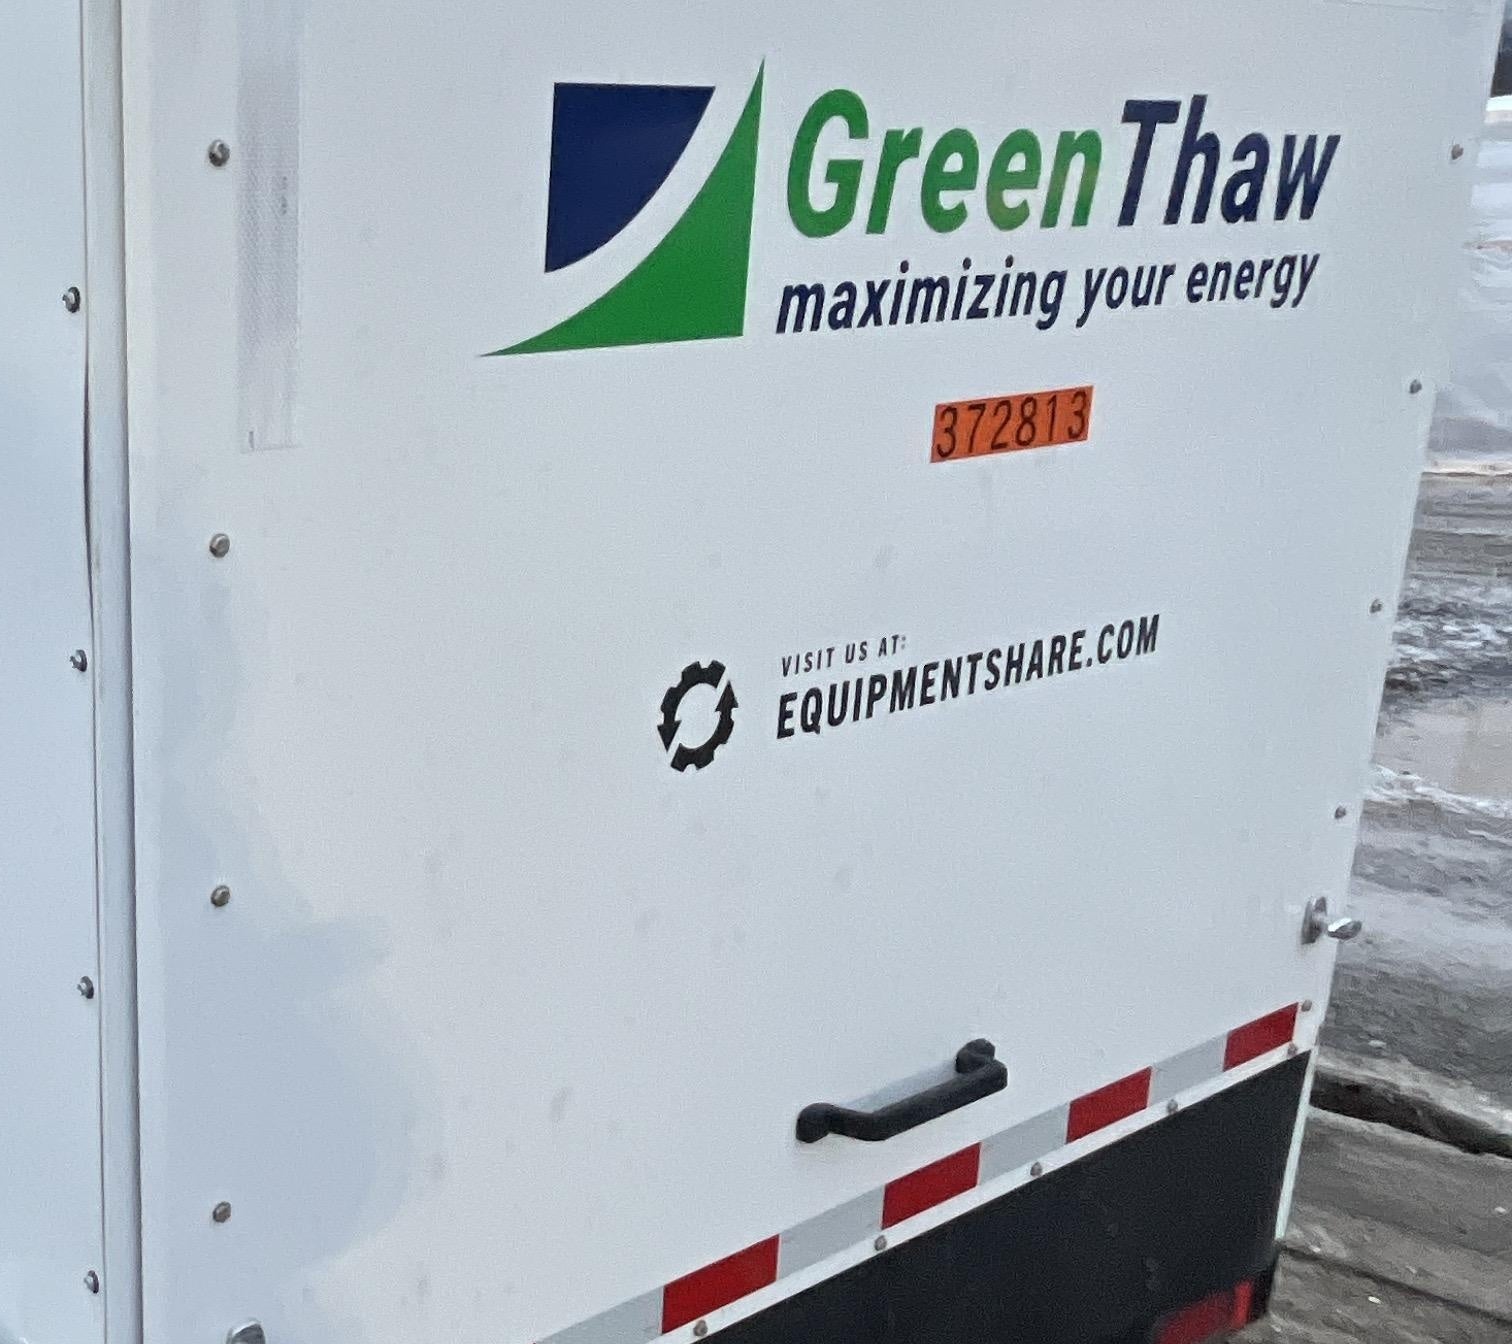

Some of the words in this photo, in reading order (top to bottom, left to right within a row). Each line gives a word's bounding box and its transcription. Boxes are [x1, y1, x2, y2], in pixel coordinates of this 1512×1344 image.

[775, 254, 1068, 335] maximizing
[1075, 263, 1176, 328] your
[1186, 253, 1321, 310] energy
[935, 388, 1089, 459] 372813
[776, 613, 1160, 740] EQUIPMENTSHARE.COM
[781, 646, 836, 678] VISIT
[845, 641, 868, 664] US
[878, 634, 907, 658] AT:
